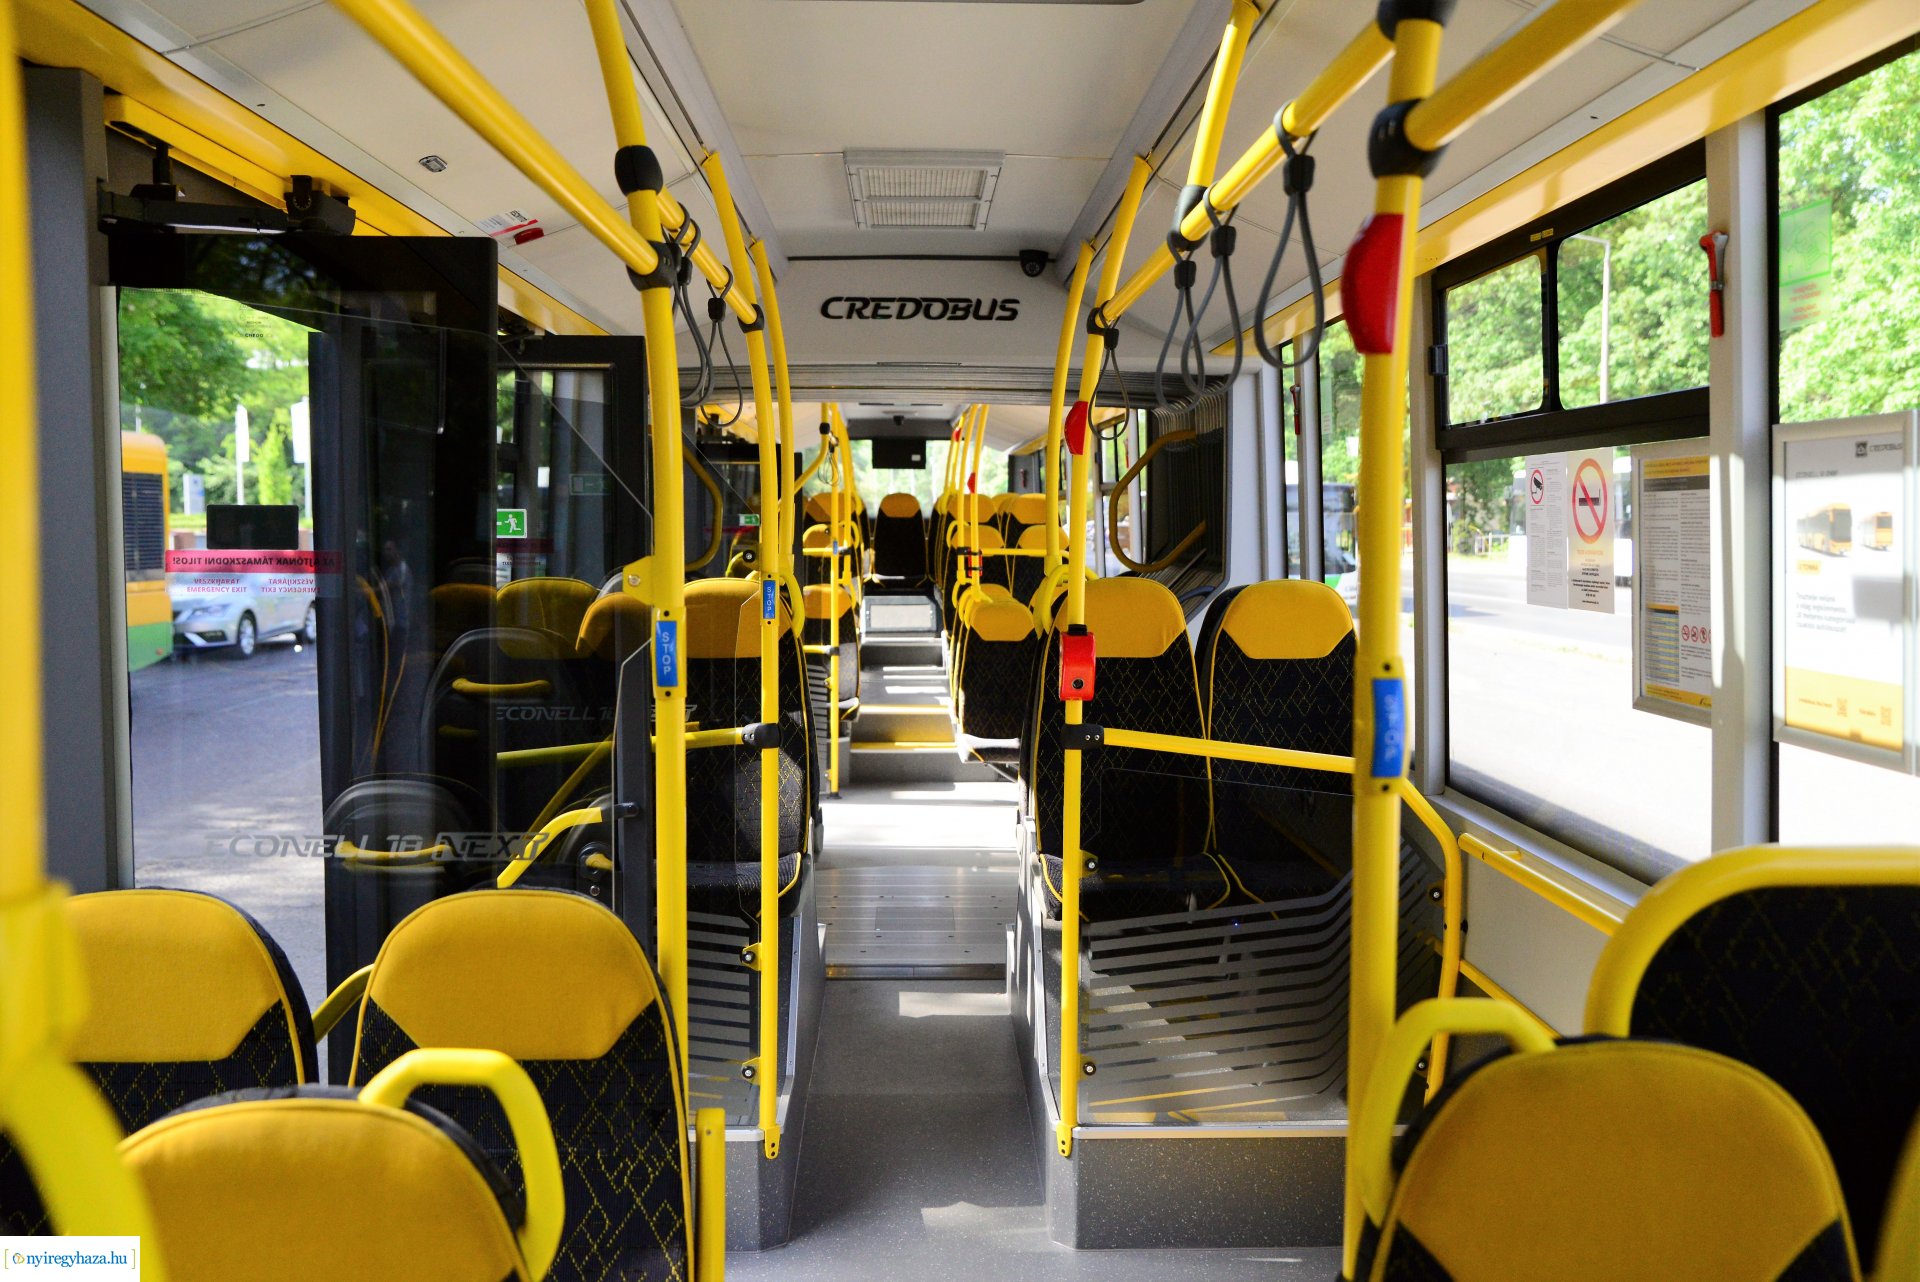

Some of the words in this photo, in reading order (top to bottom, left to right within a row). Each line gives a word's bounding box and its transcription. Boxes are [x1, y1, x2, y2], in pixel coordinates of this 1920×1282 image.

[820, 296, 1020, 321] CREDOBUS
[662, 631, 672, 676] STOP
[204, 834, 381, 859] ECONELL
[386, 834, 424, 859] 18
[436, 834, 548, 860] NEXT
